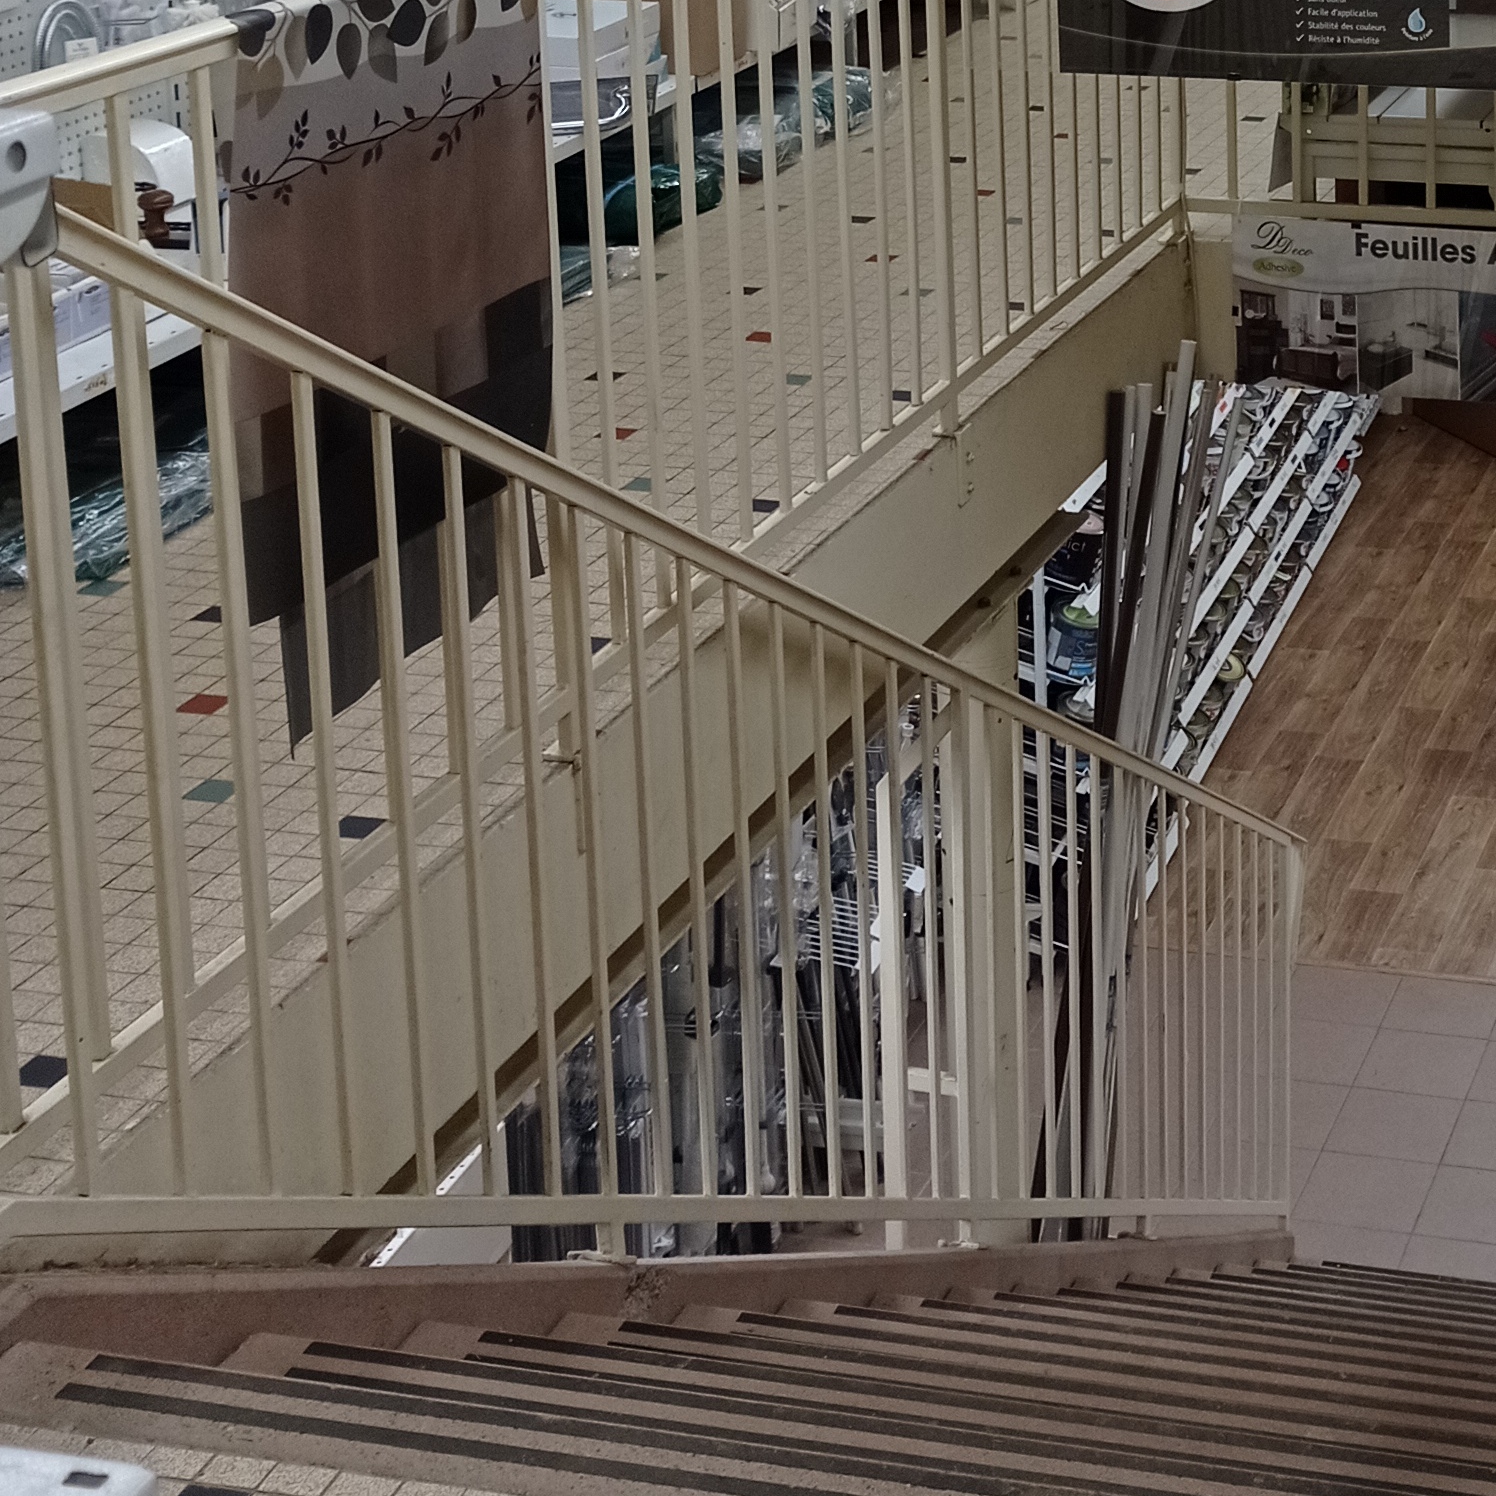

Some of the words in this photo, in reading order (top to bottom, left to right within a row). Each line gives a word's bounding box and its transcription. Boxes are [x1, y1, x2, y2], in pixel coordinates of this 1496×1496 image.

[1307, 8, 1329, 17] Facile
[1330, 8, 1378, 18] d'application
[1307, 21, 1339, 31] Stabilité
[1341, 22, 1354, 31] des
[1355, 24, 1387, 32] couleurs
[1308, 34, 1334, 43] Résiste
[1343, 35, 1380, 45] l'humidité
[1354, 233, 1477, 265] Feuilles
